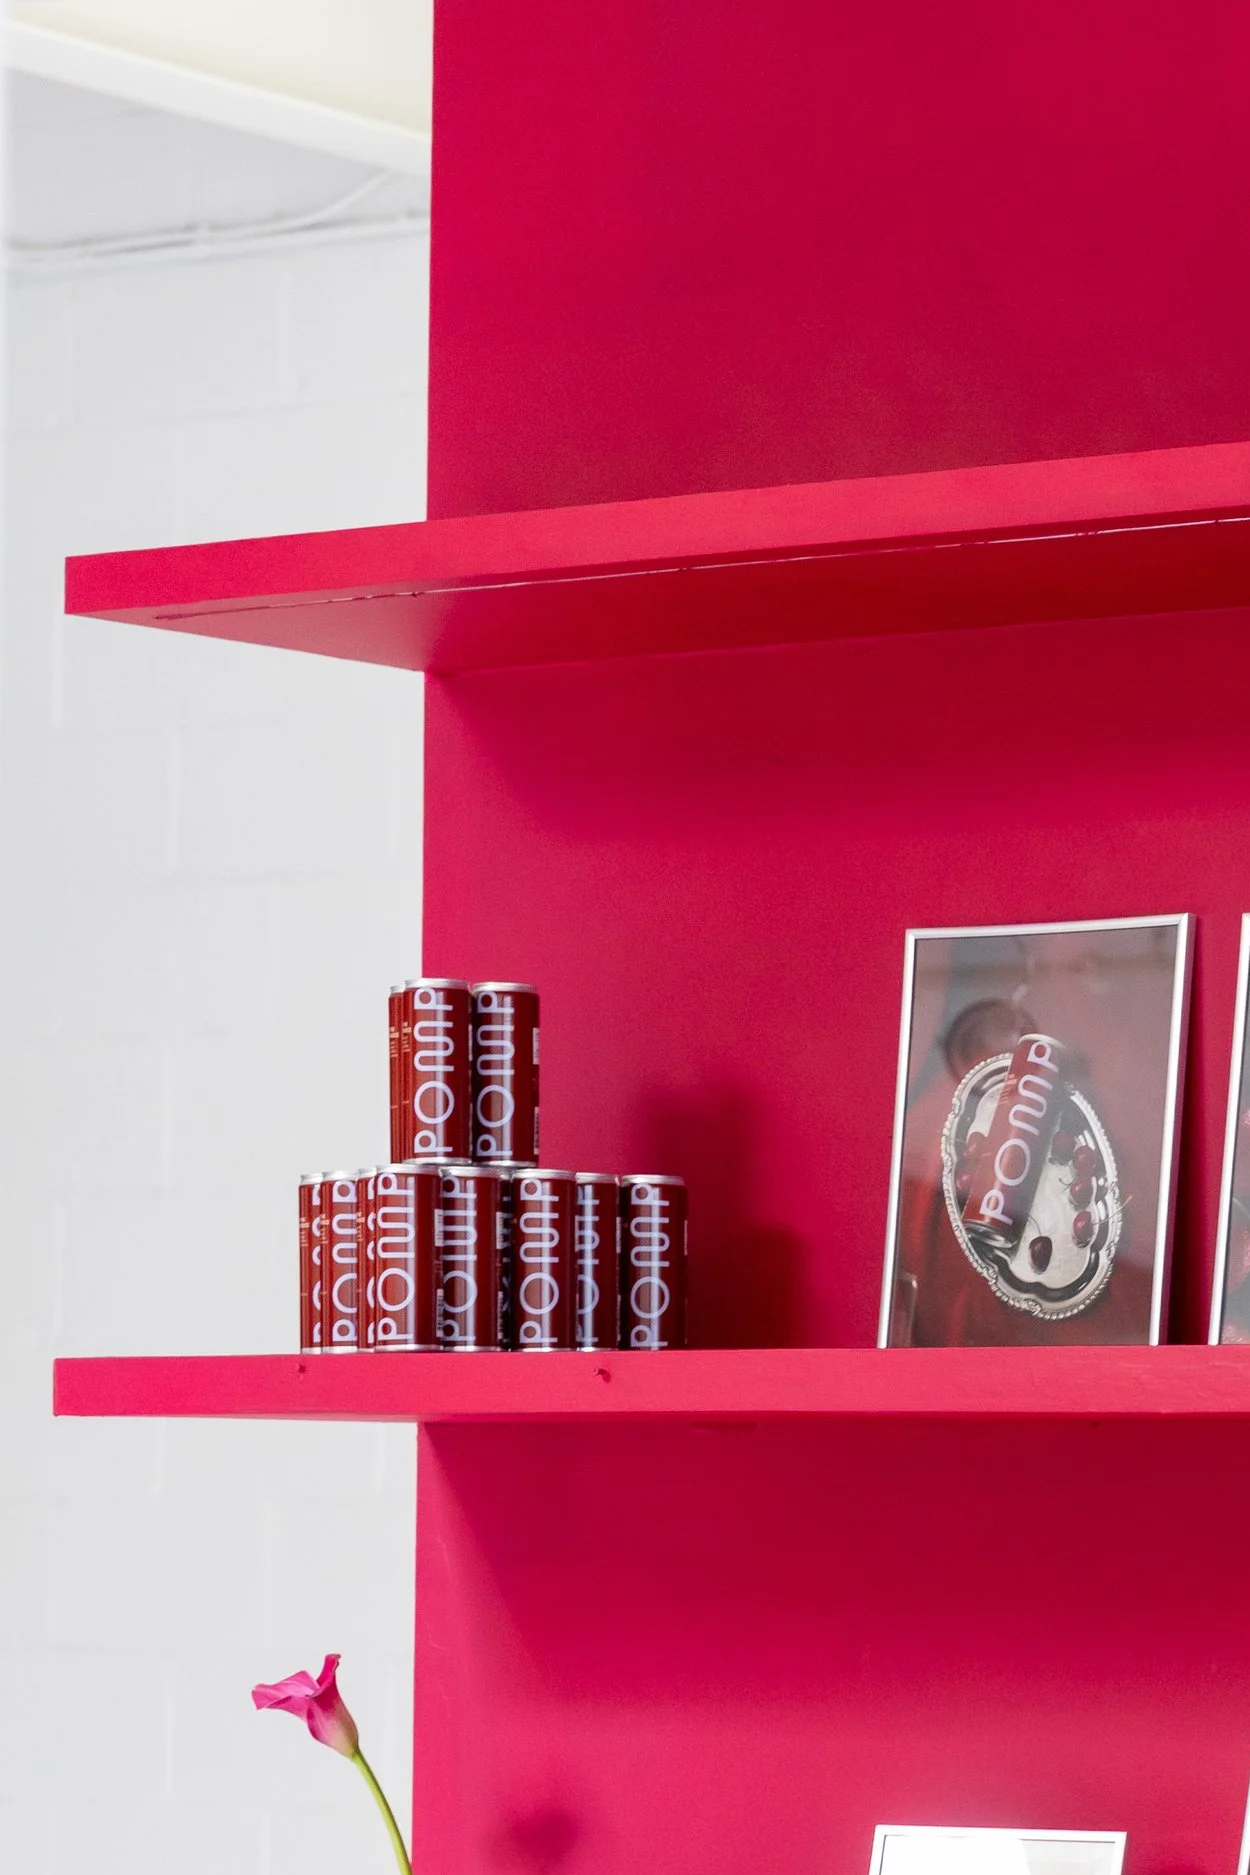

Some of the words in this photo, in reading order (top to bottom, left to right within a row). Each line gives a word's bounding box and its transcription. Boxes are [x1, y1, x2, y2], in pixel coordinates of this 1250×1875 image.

[414, 987, 453, 1153] POMP
[477, 990, 515, 1157] POMP
[980, 1041, 1058, 1225] POMP
[377, 1172, 415, 1341] POMP
[520, 1178, 559, 1343] POMP
[631, 1183, 670, 1346] POMP
